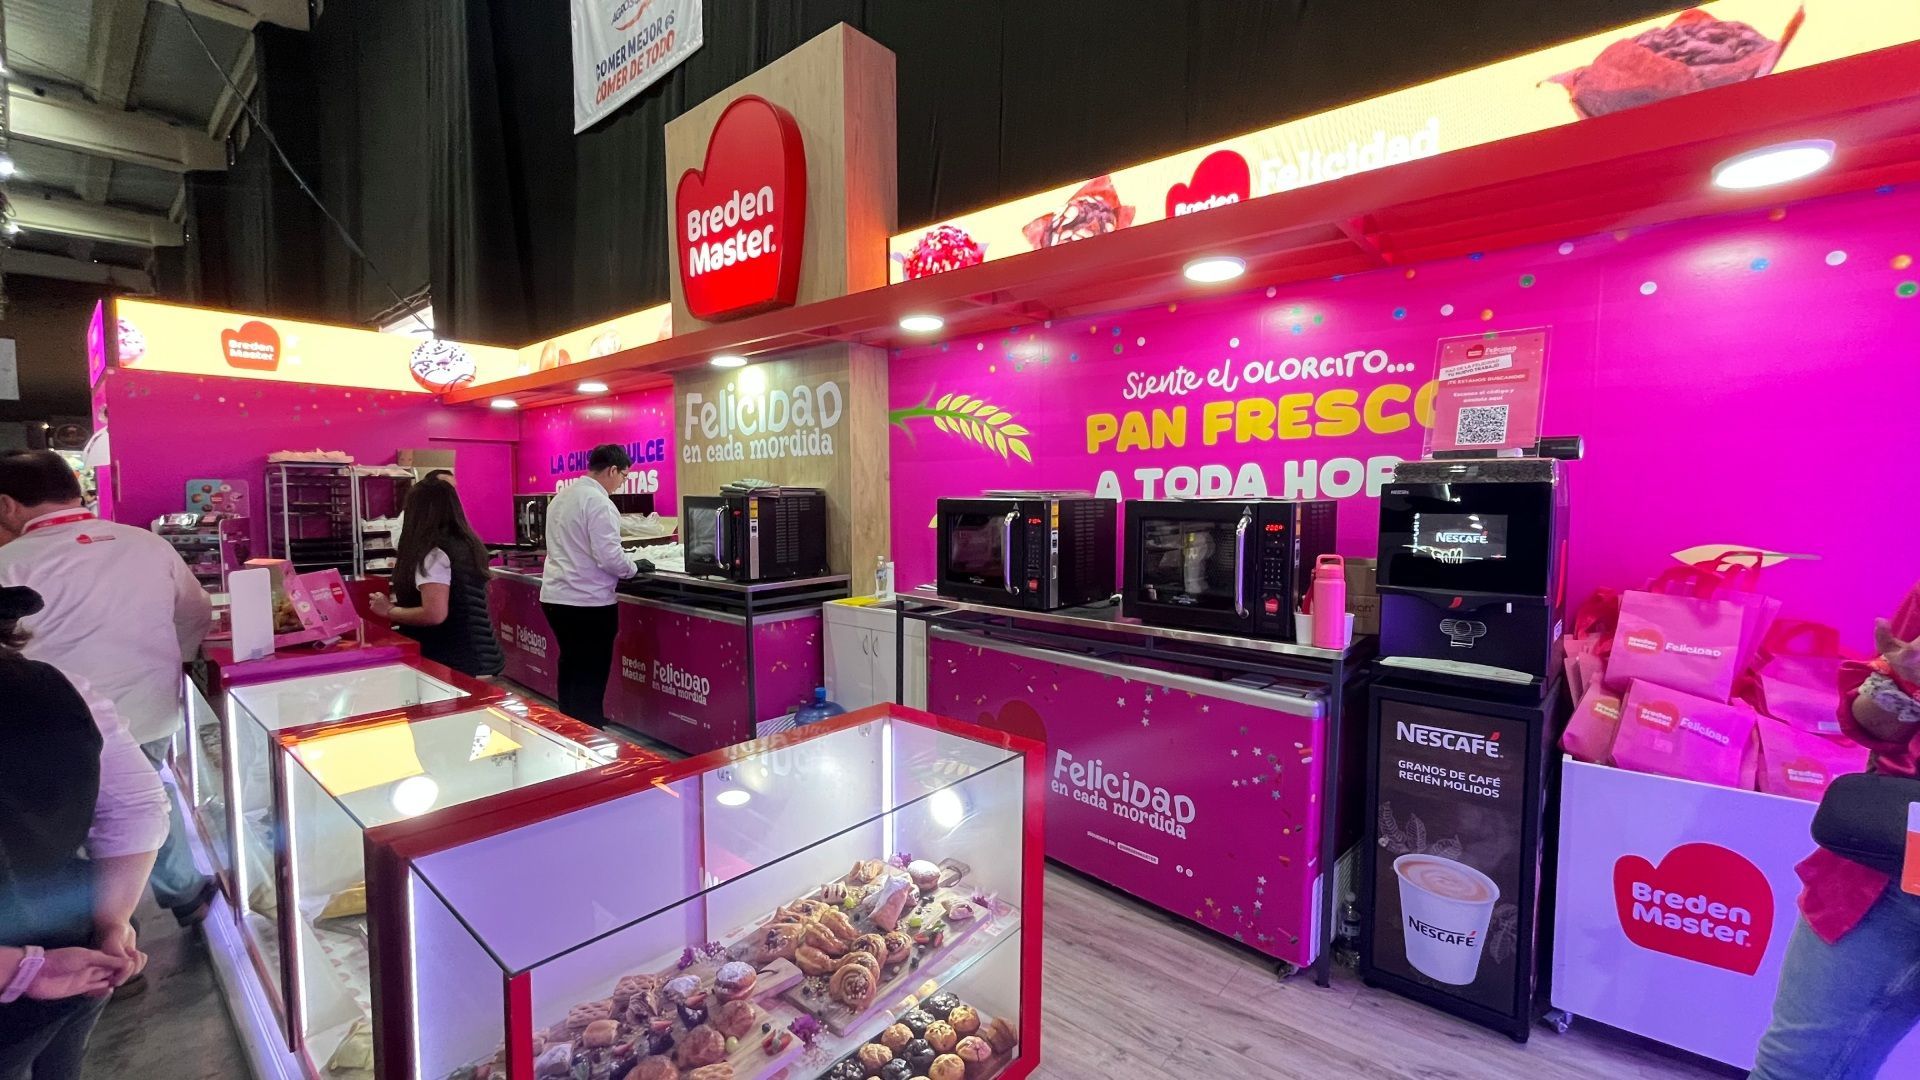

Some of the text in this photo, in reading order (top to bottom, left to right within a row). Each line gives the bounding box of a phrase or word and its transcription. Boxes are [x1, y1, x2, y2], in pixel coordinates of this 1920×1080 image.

[596, 45, 626, 81] COMER
[627, 17, 663, 58] MEJOR
[596, 30, 675, 105] COMER DE TODO
[687, 185, 774, 242] Breden
[1122, 349, 1415, 400] Siente el OLORCITO...
[682, 427, 834, 464] en cada mordida
[1085, 405, 1187, 454] PAN
[550, 454, 565, 475] LA
[625, 438, 665, 464] ULCE
[1094, 470, 1123, 503] A
[1133, 462, 1268, 500] TODA
[622, 655, 646, 671] Breden
[622, 667, 646, 683] Master
[1396, 720, 1501, 758] NESCAFÉ
[1398, 759, 1501, 788] GRANOS DE CAFÉ
[1398, 769, 1500, 799] RECIÉN MOLIDOS
[1051, 778, 1187, 840] en cada mordida
[1631, 881, 1751, 926] Breden
[1408, 915, 1478, 948] NESCAFÉ
